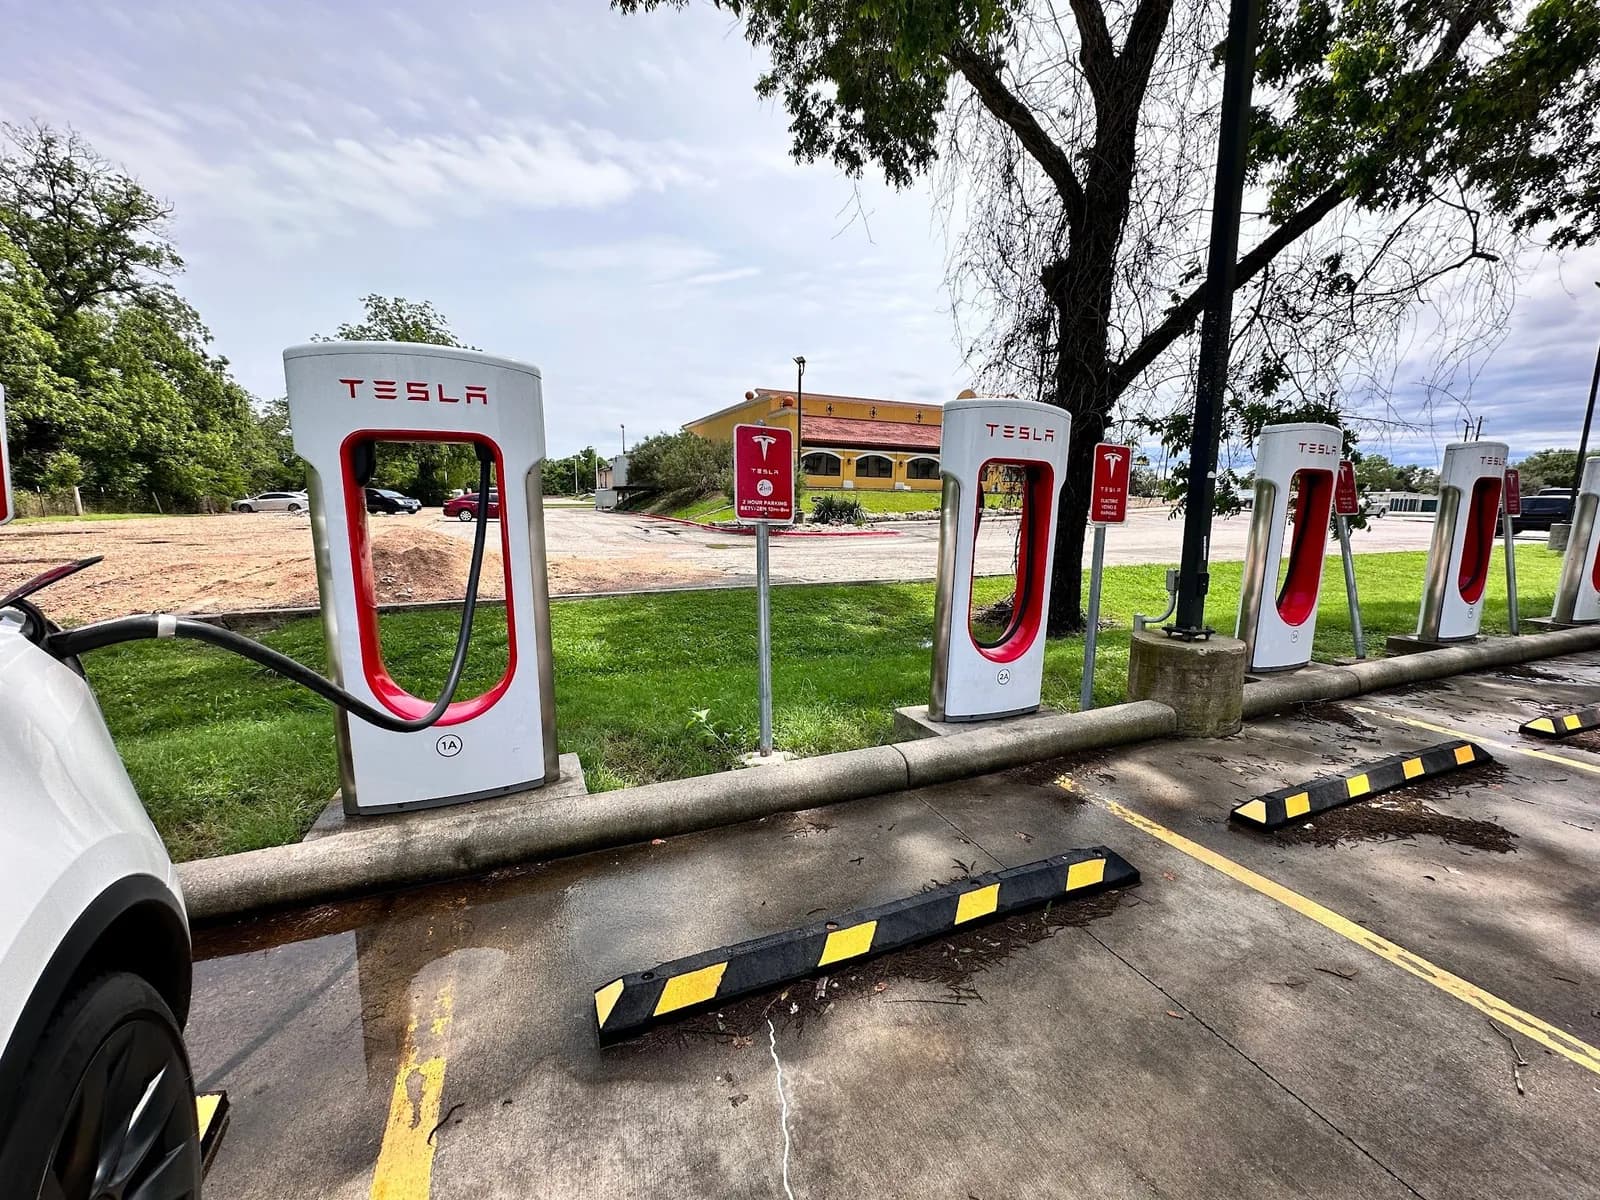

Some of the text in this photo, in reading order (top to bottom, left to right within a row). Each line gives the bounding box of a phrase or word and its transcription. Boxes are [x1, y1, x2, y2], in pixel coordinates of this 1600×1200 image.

[338, 378, 488, 405] TESLA
[986, 423, 1055, 442] TESLA
[1299, 442, 1337, 455] TESLA
[442, 740, 457, 750] 1A
